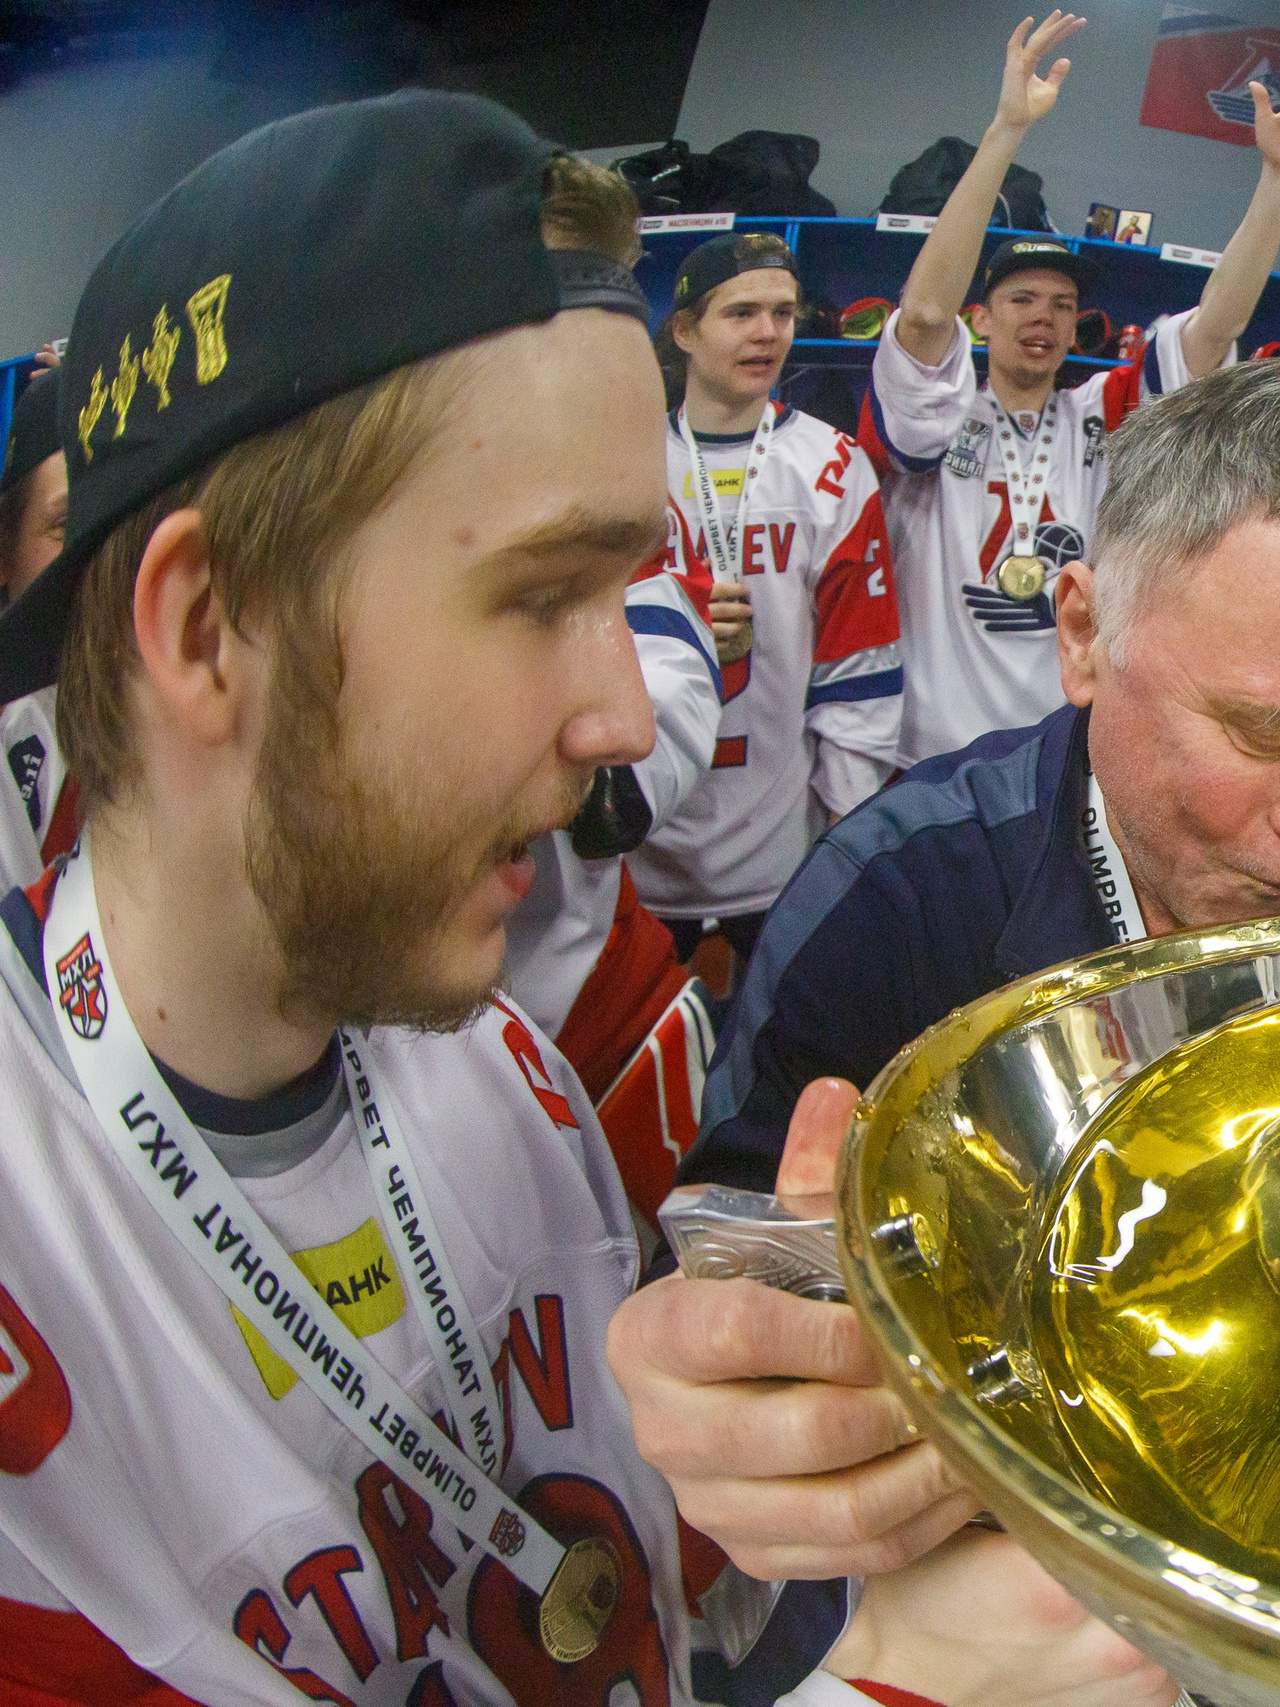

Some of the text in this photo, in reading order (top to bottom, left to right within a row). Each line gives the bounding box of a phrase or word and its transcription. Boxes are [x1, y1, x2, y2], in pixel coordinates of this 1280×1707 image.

[1081, 807, 1130, 942] OLIMPBE
[119, 1090, 478, 1513] OLIMPBET ЧЕМПИОНАТ МХЛ
[318, 1255, 392, 1308] АНК
[388, 1165, 482, 1398] ЧЕМПИОНАТ
[470, 1405, 498, 1478] МХЛ
